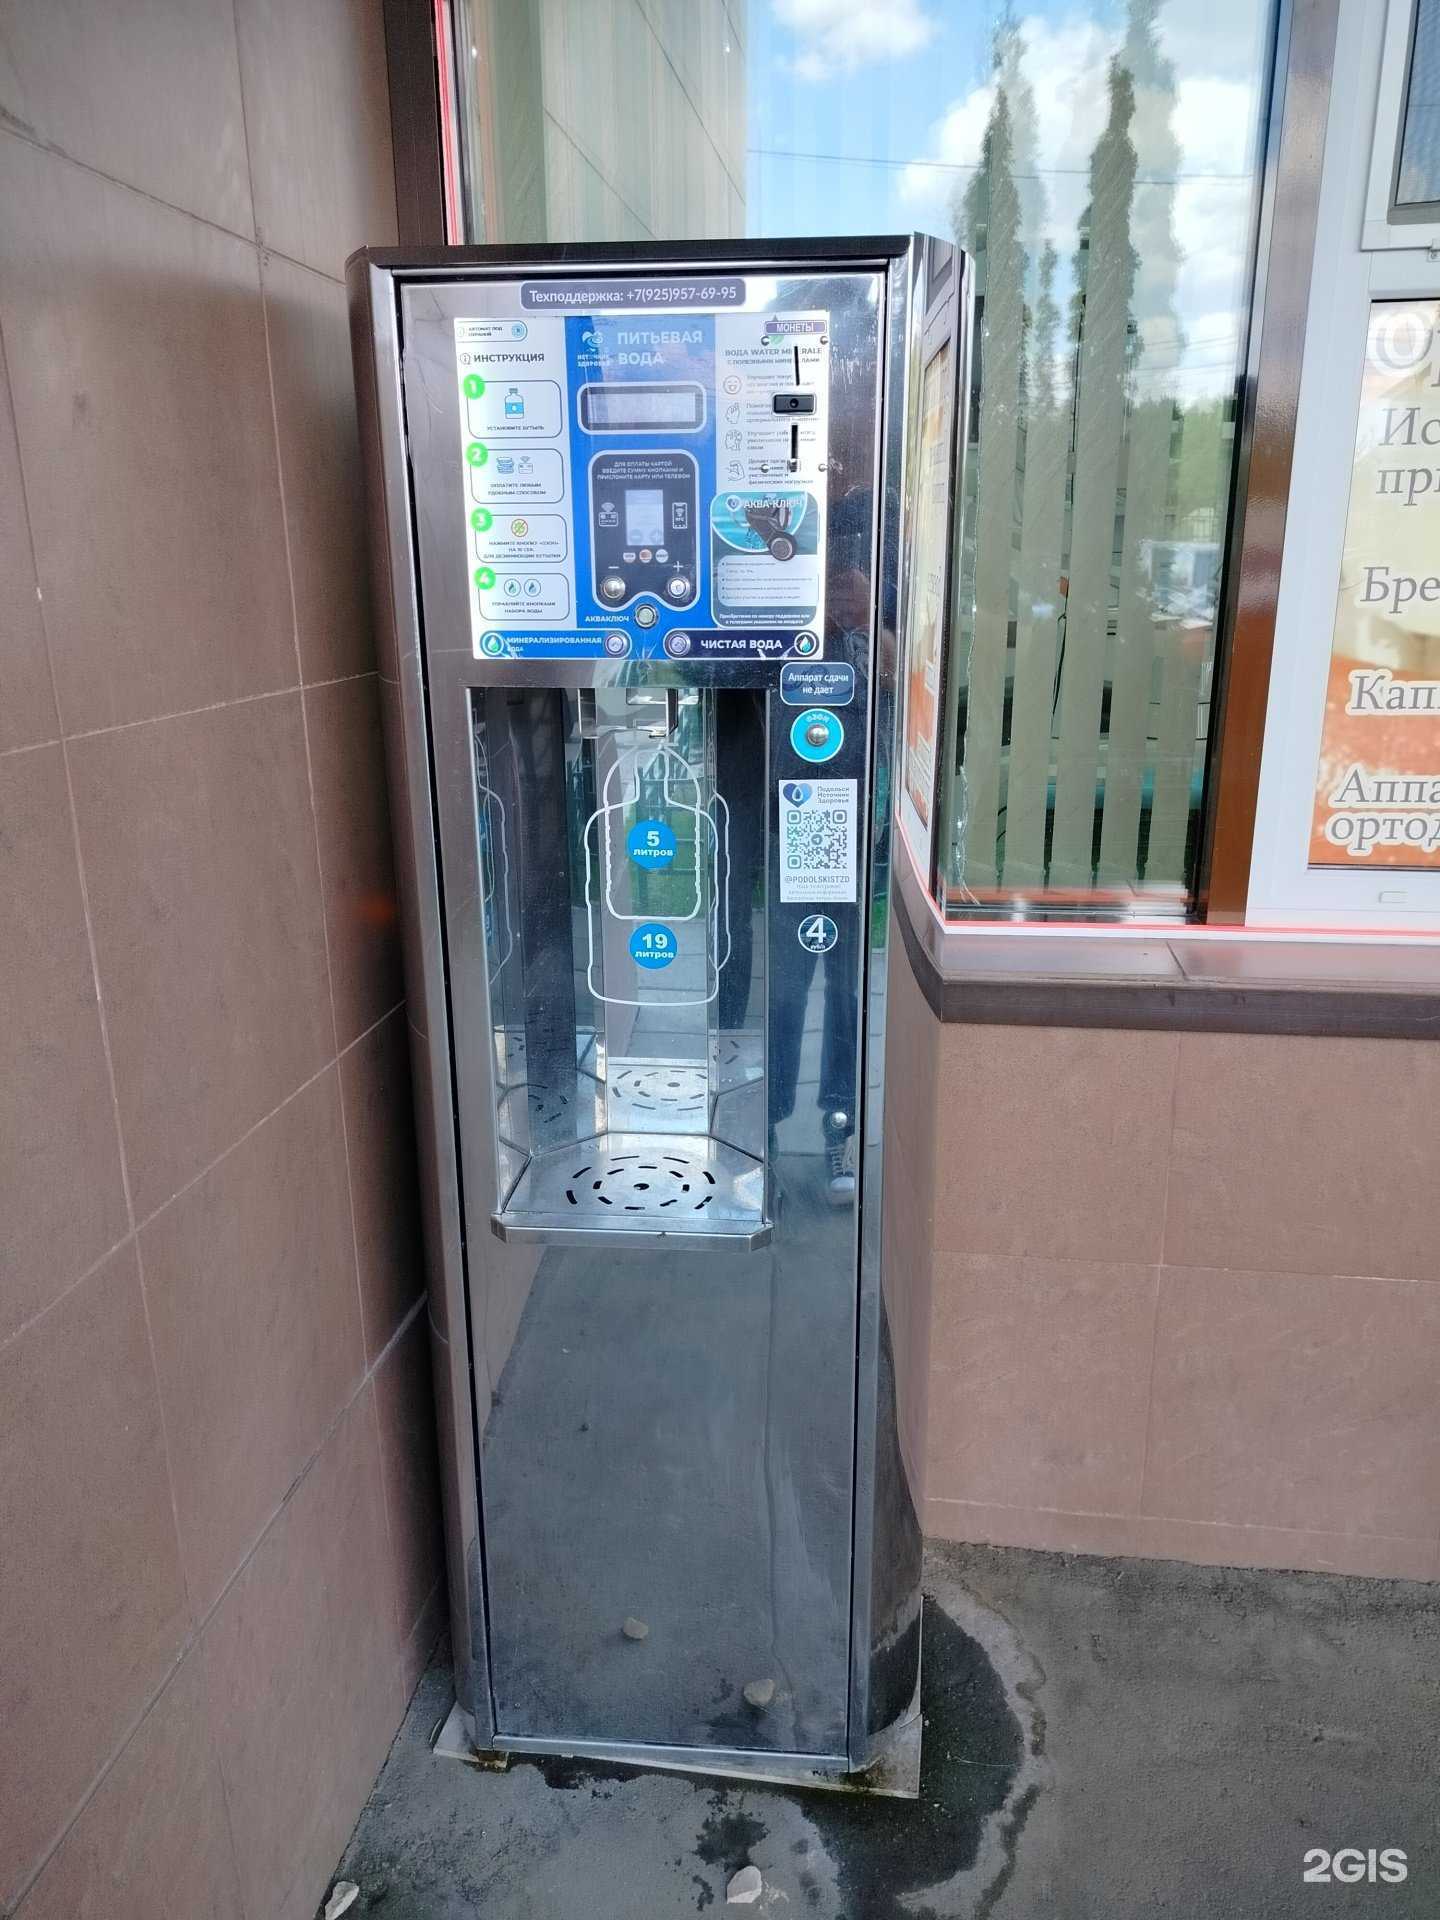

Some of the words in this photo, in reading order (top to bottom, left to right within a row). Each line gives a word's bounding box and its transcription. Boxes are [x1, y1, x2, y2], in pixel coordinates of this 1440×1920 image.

[529, 289, 624, 305] Техподдержка:
[626, 286, 736, 302] +7(925)957-69-95
[776, 322, 815, 333] МОНЕТЫ
[617, 330, 703, 345] ПИТЬЕВАЯ
[473, 353, 545, 364] ИНСТРУКЦИЯ
[750, 348, 780, 356] WATER
[618, 352, 664, 367] ВОДА
[1359, 566, 1440, 614] Бре
[700, 639, 746, 649] ЧИСТАЯ
[749, 639, 783, 649] ВОДА
[788, 673, 822, 683] Аппарат
[824, 674, 849, 683] сдачи
[803, 686, 814, 694] не
[813, 686, 834, 695] дает
[1352, 675, 1440, 710] Кап
[646, 831, 661, 847] 5
[633, 849, 674, 858] литров
[806, 917, 827, 944] 4
[642, 933, 668, 950] 19
[634, 951, 675, 960] литров
